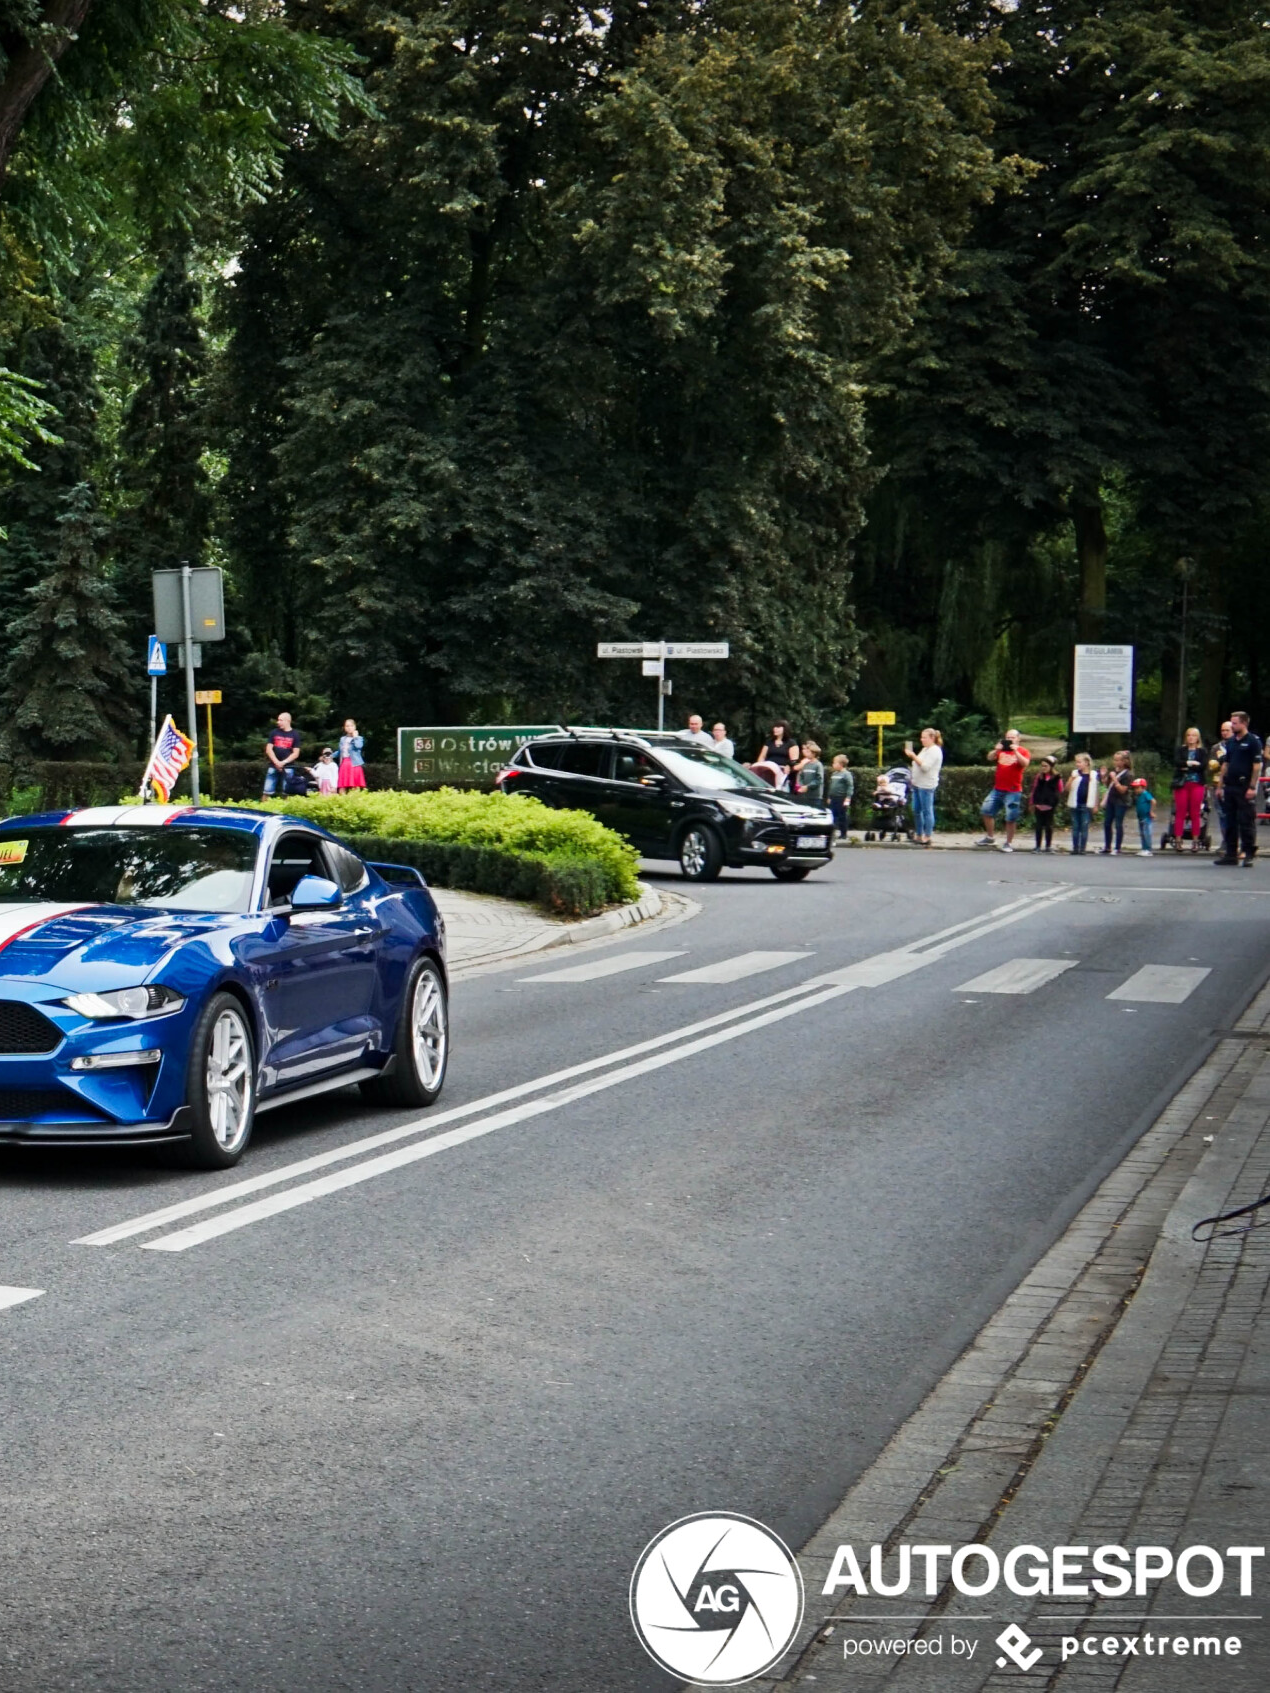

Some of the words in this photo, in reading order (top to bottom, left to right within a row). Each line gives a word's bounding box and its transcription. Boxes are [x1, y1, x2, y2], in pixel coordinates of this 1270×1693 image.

[612, 646, 643, 654] Piastowsk
[686, 646, 724, 654] Piastowska
[416, 739, 432, 750] 36
[441, 735, 512, 752] Ostrów
